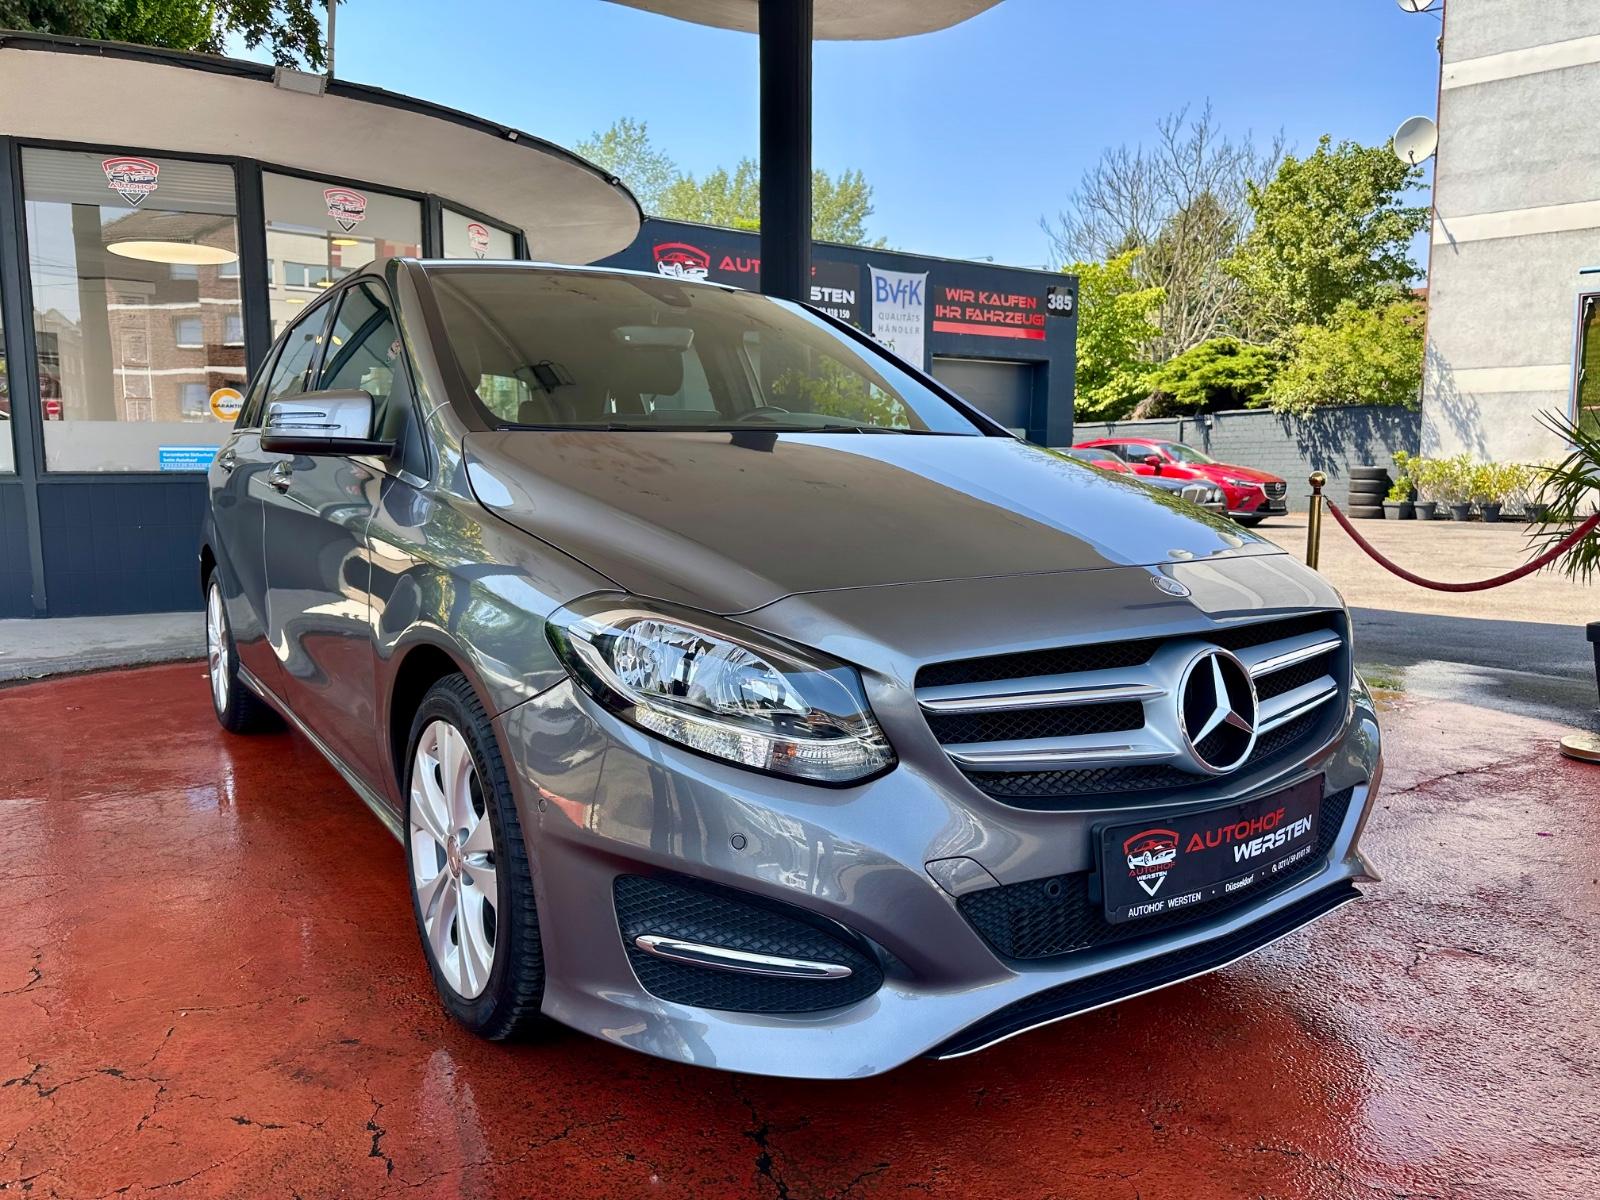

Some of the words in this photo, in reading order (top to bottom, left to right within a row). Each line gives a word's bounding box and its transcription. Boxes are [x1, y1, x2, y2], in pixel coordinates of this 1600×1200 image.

[945, 287, 975, 303] WIR
[978, 291, 1037, 309] KAUFEN
[1047, 294, 1073, 310] 385
[878, 312, 920, 322] QUALITÄTS
[935, 304, 962, 319] IHR
[878, 325, 920, 334] HÄNDLER
[1185, 807, 1286, 853] AUTOHOF
[1233, 814, 1312, 863] WERSTEN
[1128, 861, 1176, 877] AUTOHOF
[1136, 870, 1168, 881] WERSTEN
[1128, 900, 1165, 918] AUTOHOF
[1167, 891, 1202, 908] WERSTEN
[1225, 873, 1254, 892] Düsseldorf
